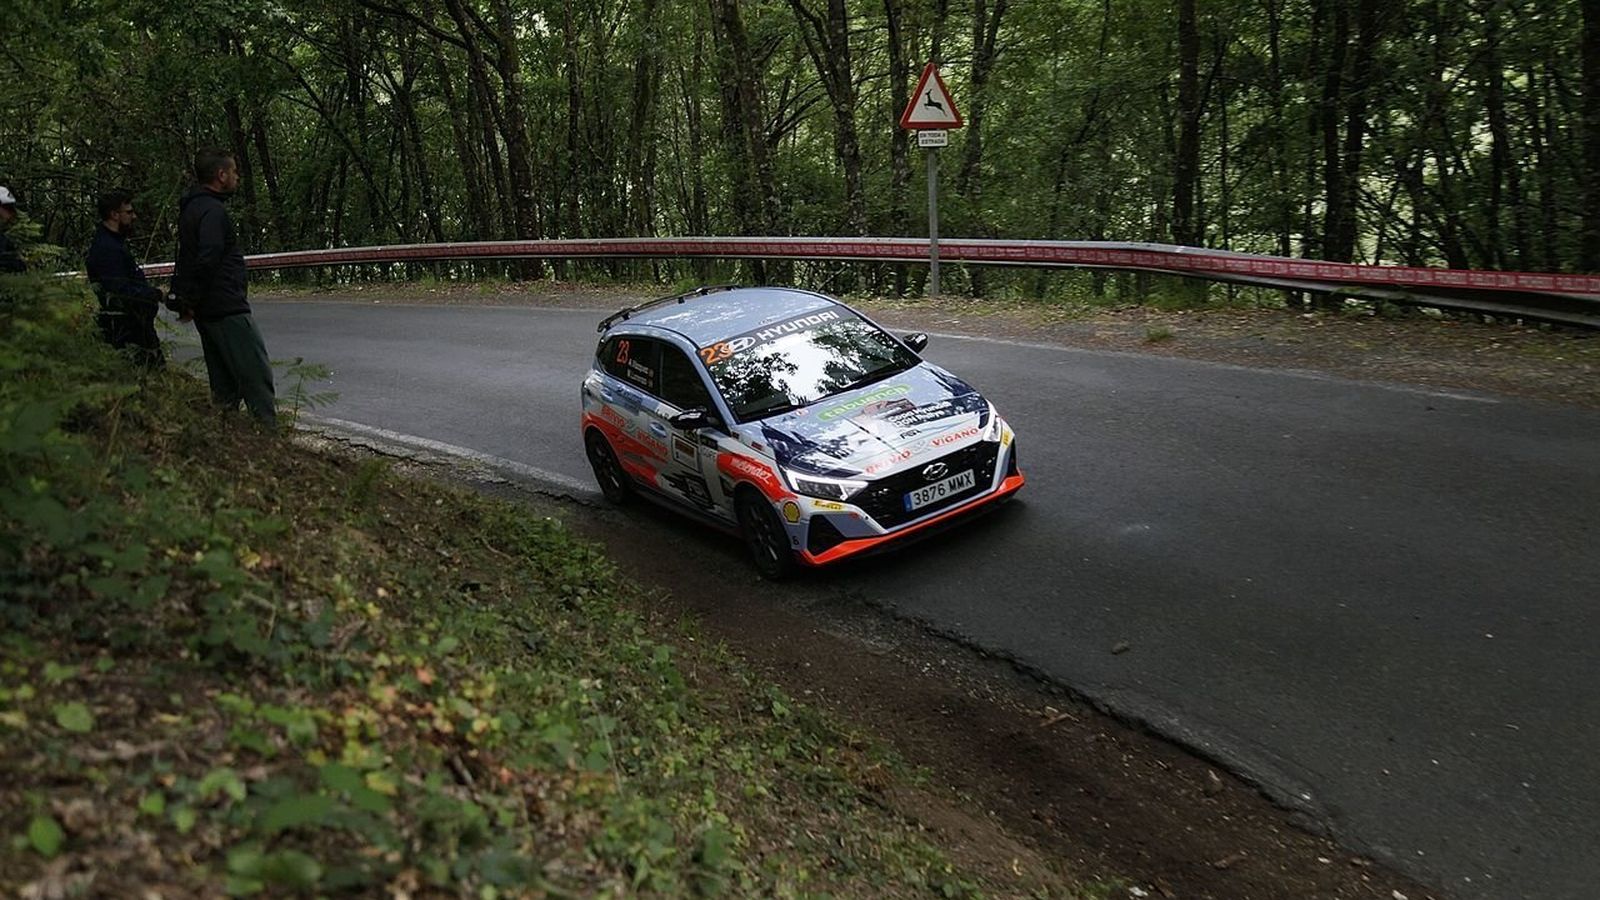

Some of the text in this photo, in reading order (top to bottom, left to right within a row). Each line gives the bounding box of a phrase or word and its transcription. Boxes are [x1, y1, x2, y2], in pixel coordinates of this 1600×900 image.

[756, 310, 840, 341] HYUNDAI
[616, 339, 630, 365] 23
[700, 341, 733, 365] 23
[931, 427, 979, 446] VIGANO
[913, 472, 973, 506] 3876 MMX
